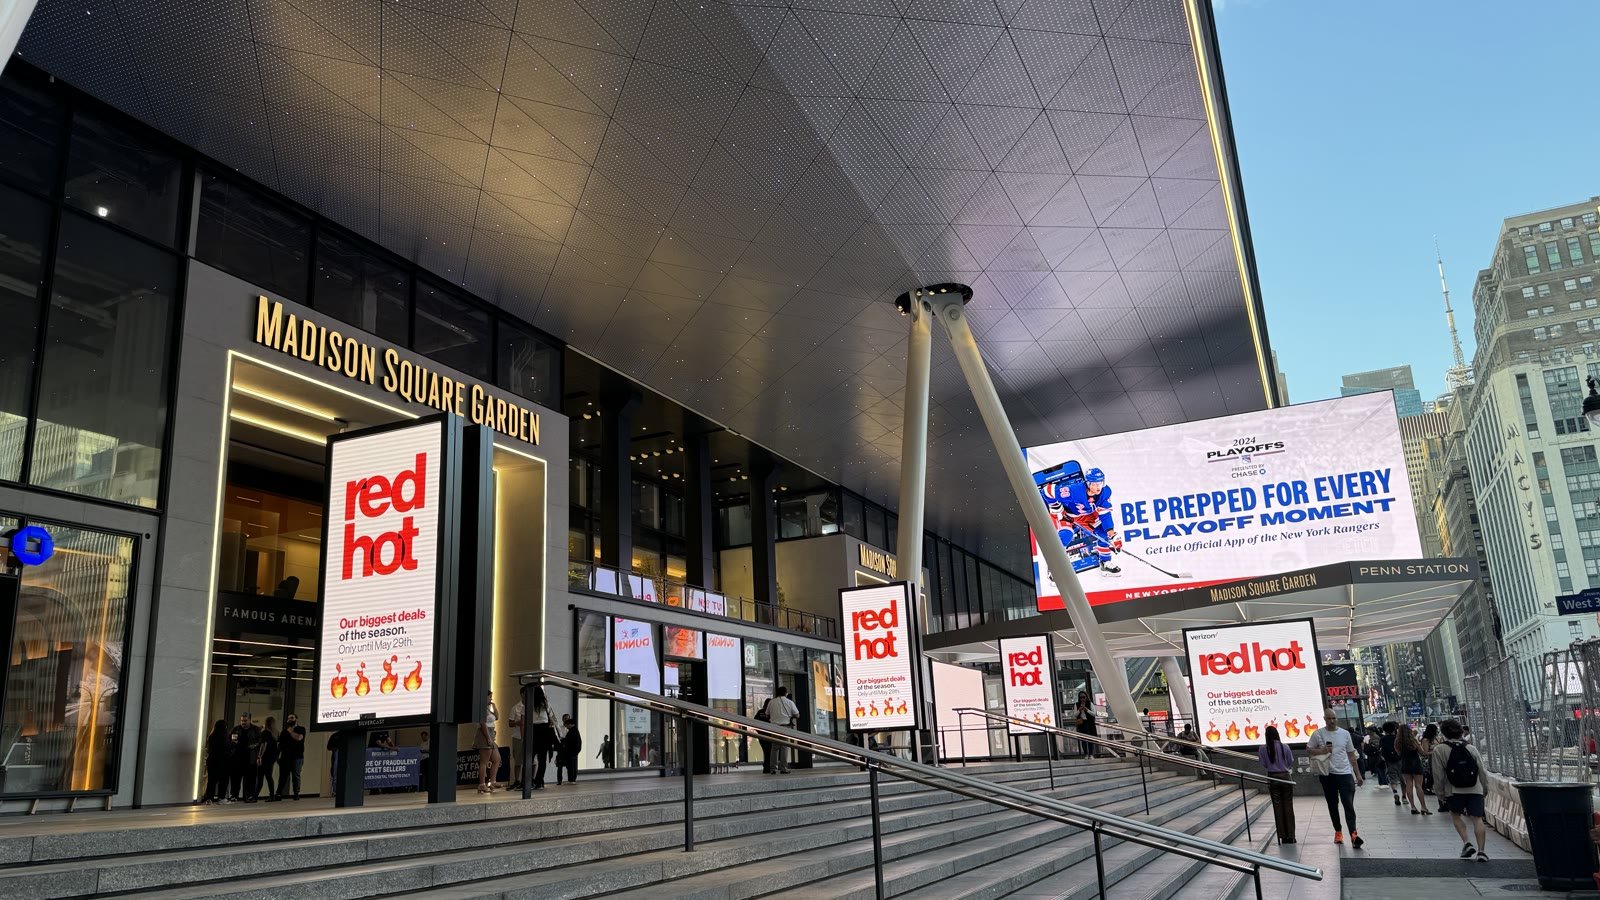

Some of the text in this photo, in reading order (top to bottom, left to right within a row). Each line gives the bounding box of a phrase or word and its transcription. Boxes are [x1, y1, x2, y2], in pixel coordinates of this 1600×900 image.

[256, 295, 540, 446] MADISON SQUARE GARDEN
[1206, 441, 1285, 459] PLAYOFFS
[1233, 437, 1256, 447] 2024
[1231, 464, 1257, 472] PRESENTED
[1231, 470, 1258, 479] CHASE
[344, 452, 427, 522] red
[1507, 423, 1542, 550] MACY'S
[1121, 468, 1391, 526] BE PREPPED FOR EVERY
[1124, 498, 1396, 543] PLAYOFF MOMENT
[1145, 521, 1380, 556] Get the Official App of the New York Rangers
[342, 516, 419, 580] hot
[860, 543, 897, 579] MADISON SQU
[1359, 562, 1470, 577] PENN STATION
[1210, 573, 1317, 603] MADISON SQUARE GARDEN
[1563, 599, 1593, 609] West
[223, 607, 275, 622] FAMOUS
[339, 609, 426, 629] Our biggest deals
[851, 599, 899, 632] red
[339, 626, 407, 642] of the season.
[1190, 633, 1216, 641] verizon
[338, 637, 413, 655] Only until May 29th.
[853, 631, 898, 660] hot
[1008, 645, 1042, 667] red
[1198, 640, 1306, 676] red hot
[868, 676, 889, 684] biggest
[1010, 666, 1043, 687] hot
[1207, 688, 1278, 699] Our biggest deals
[1232, 697, 1264, 706] season.
[322, 709, 347, 719] verizon
[1209, 704, 1271, 715] Only until May 29th.
[382, 758, 417, 767] FRAUDULENT
